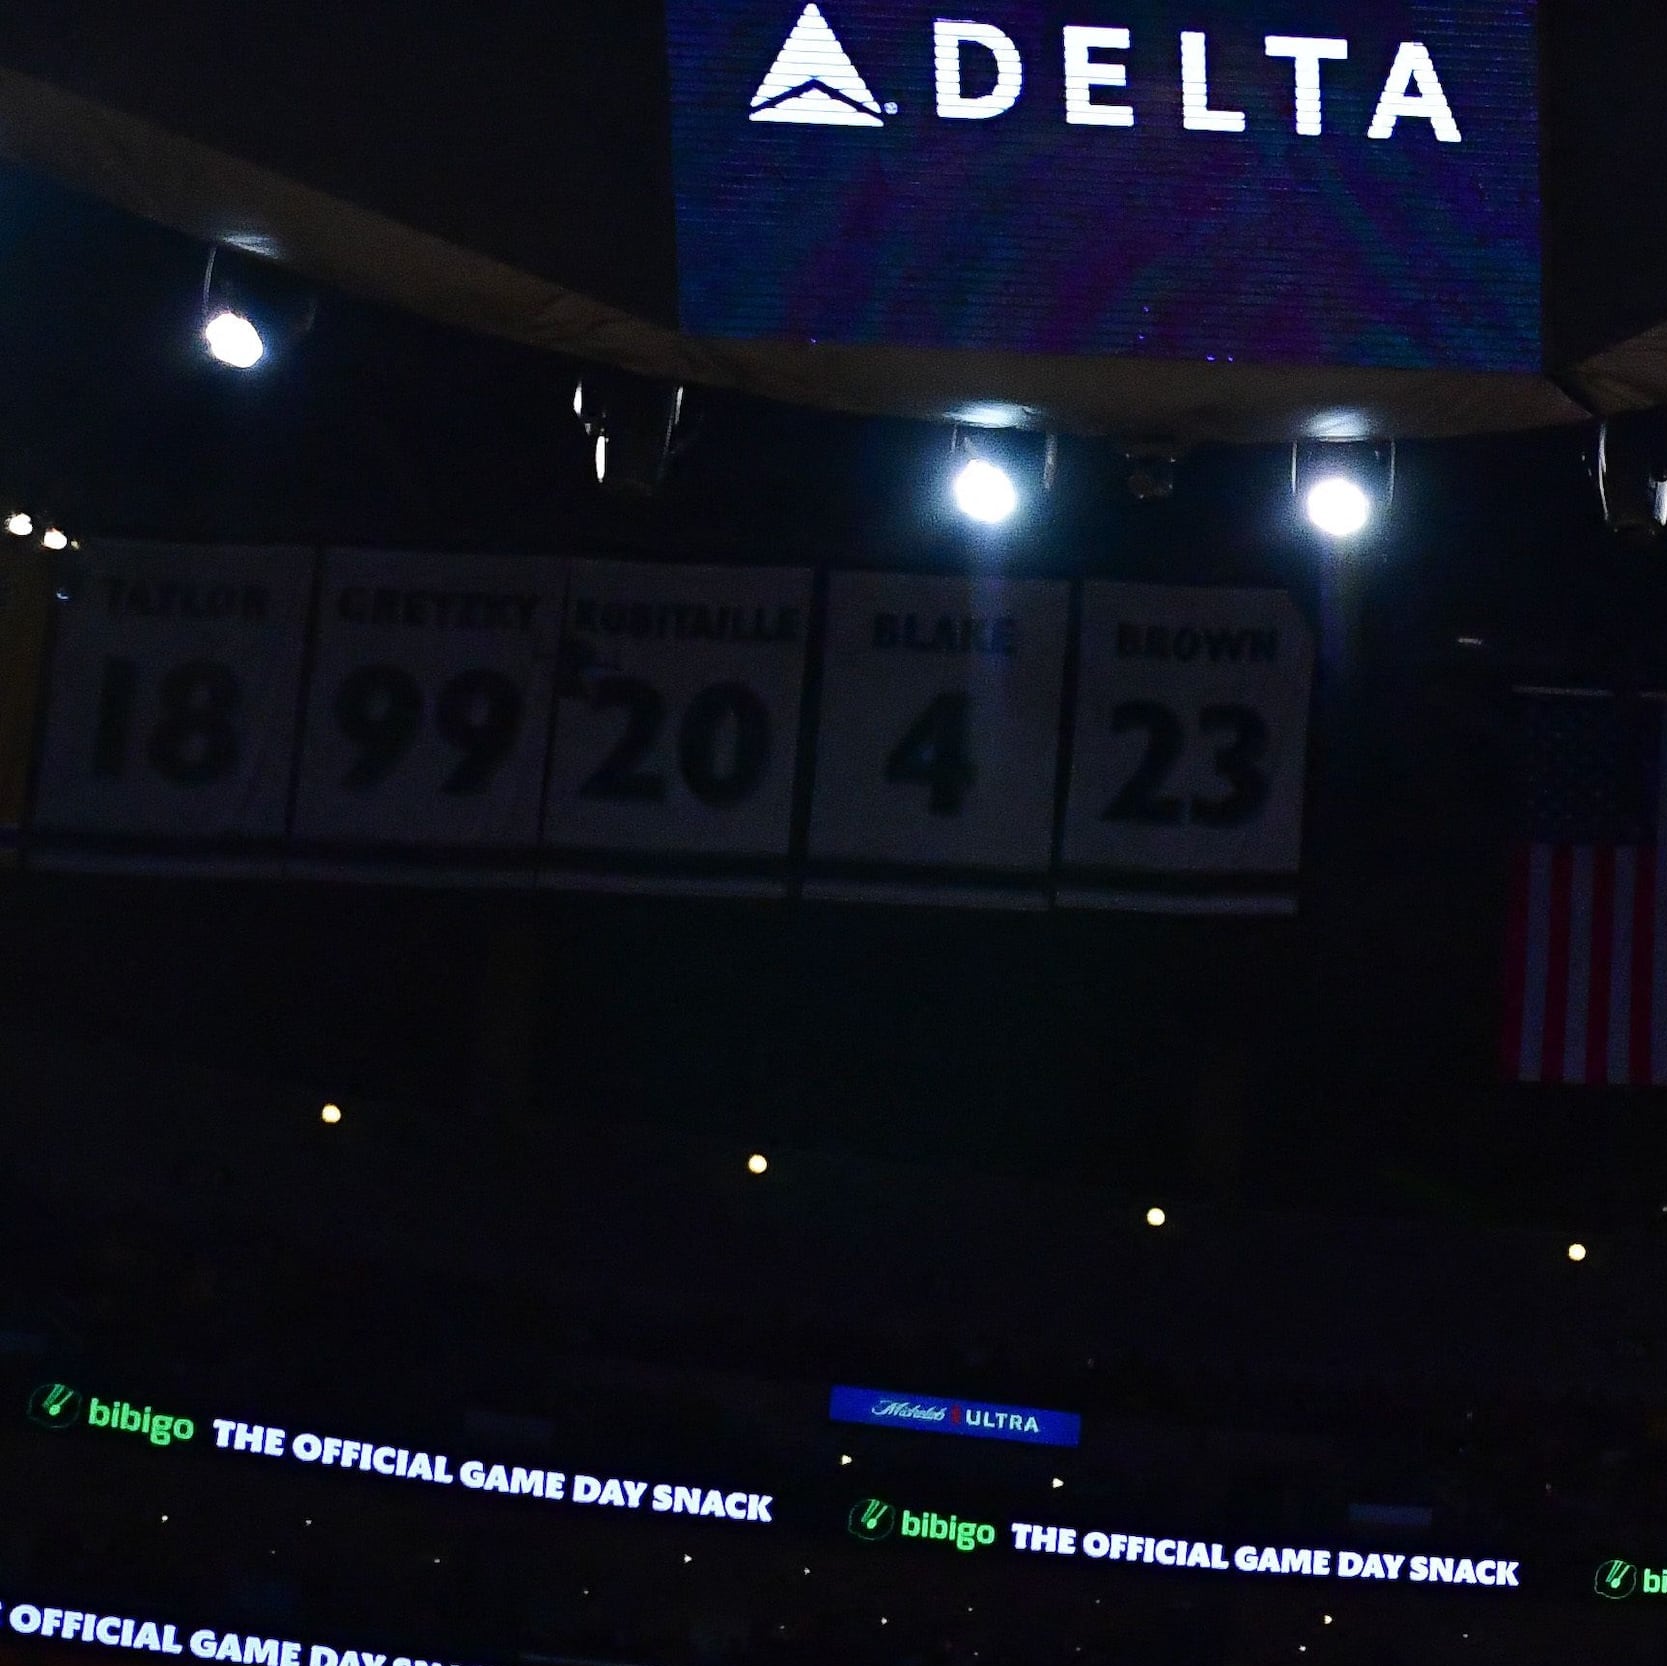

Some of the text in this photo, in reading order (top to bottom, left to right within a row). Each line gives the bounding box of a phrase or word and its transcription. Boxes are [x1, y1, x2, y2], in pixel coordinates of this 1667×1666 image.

[932, 16, 1463, 144] DELTA
[873, 612, 1018, 656] BLAKE
[1115, 622, 1277, 664] BROWN
[94, 654, 241, 788] 18
[333, 662, 524, 796] 99
[579, 675, 770, 810] 20
[885, 688, 975, 817] 4
[1101, 699, 1269, 827] 23
[89, 1398, 193, 1445] bibigo
[965, 1408, 1040, 1434] ULTRA
[213, 1419, 773, 1522] THE OFFICIAL GAME DAY SNACK
[902, 1510, 995, 1550] bibigo
[1011, 1523, 1519, 1586] THE OFFICIAL GAME DAY SNACK
[9, 1604, 183, 1654] OFFICIAL
